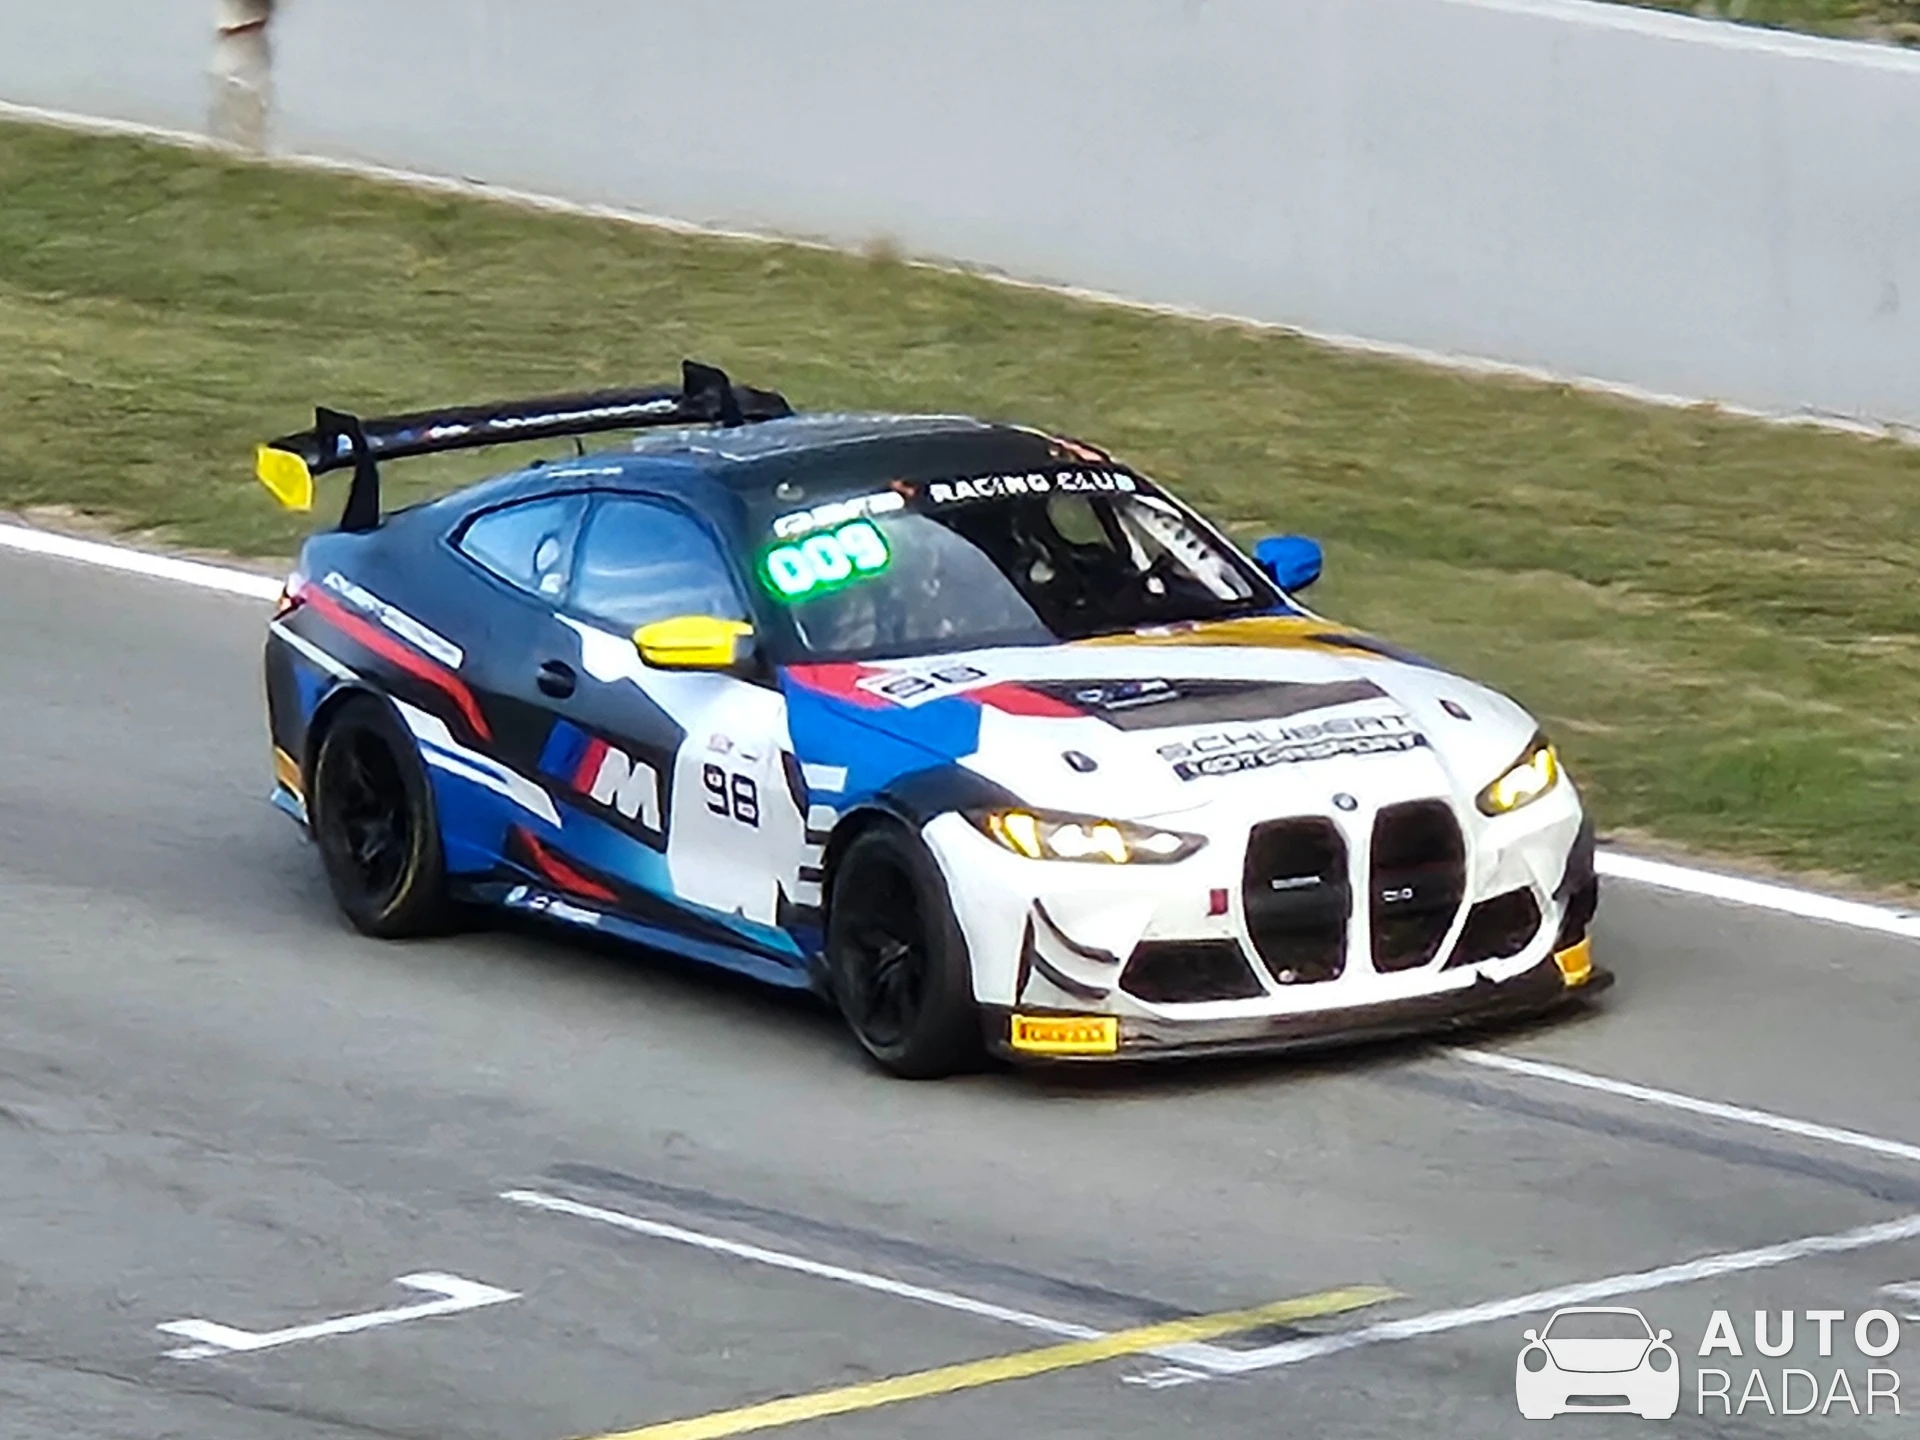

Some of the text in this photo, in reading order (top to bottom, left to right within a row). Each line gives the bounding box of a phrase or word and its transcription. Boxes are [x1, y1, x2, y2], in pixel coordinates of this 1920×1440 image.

[930, 471, 1137, 503] RACING CLUB
[767, 522, 888, 595] 009
[1155, 714, 1412, 762] SCHUBERT
[702, 762, 760, 829] 98
